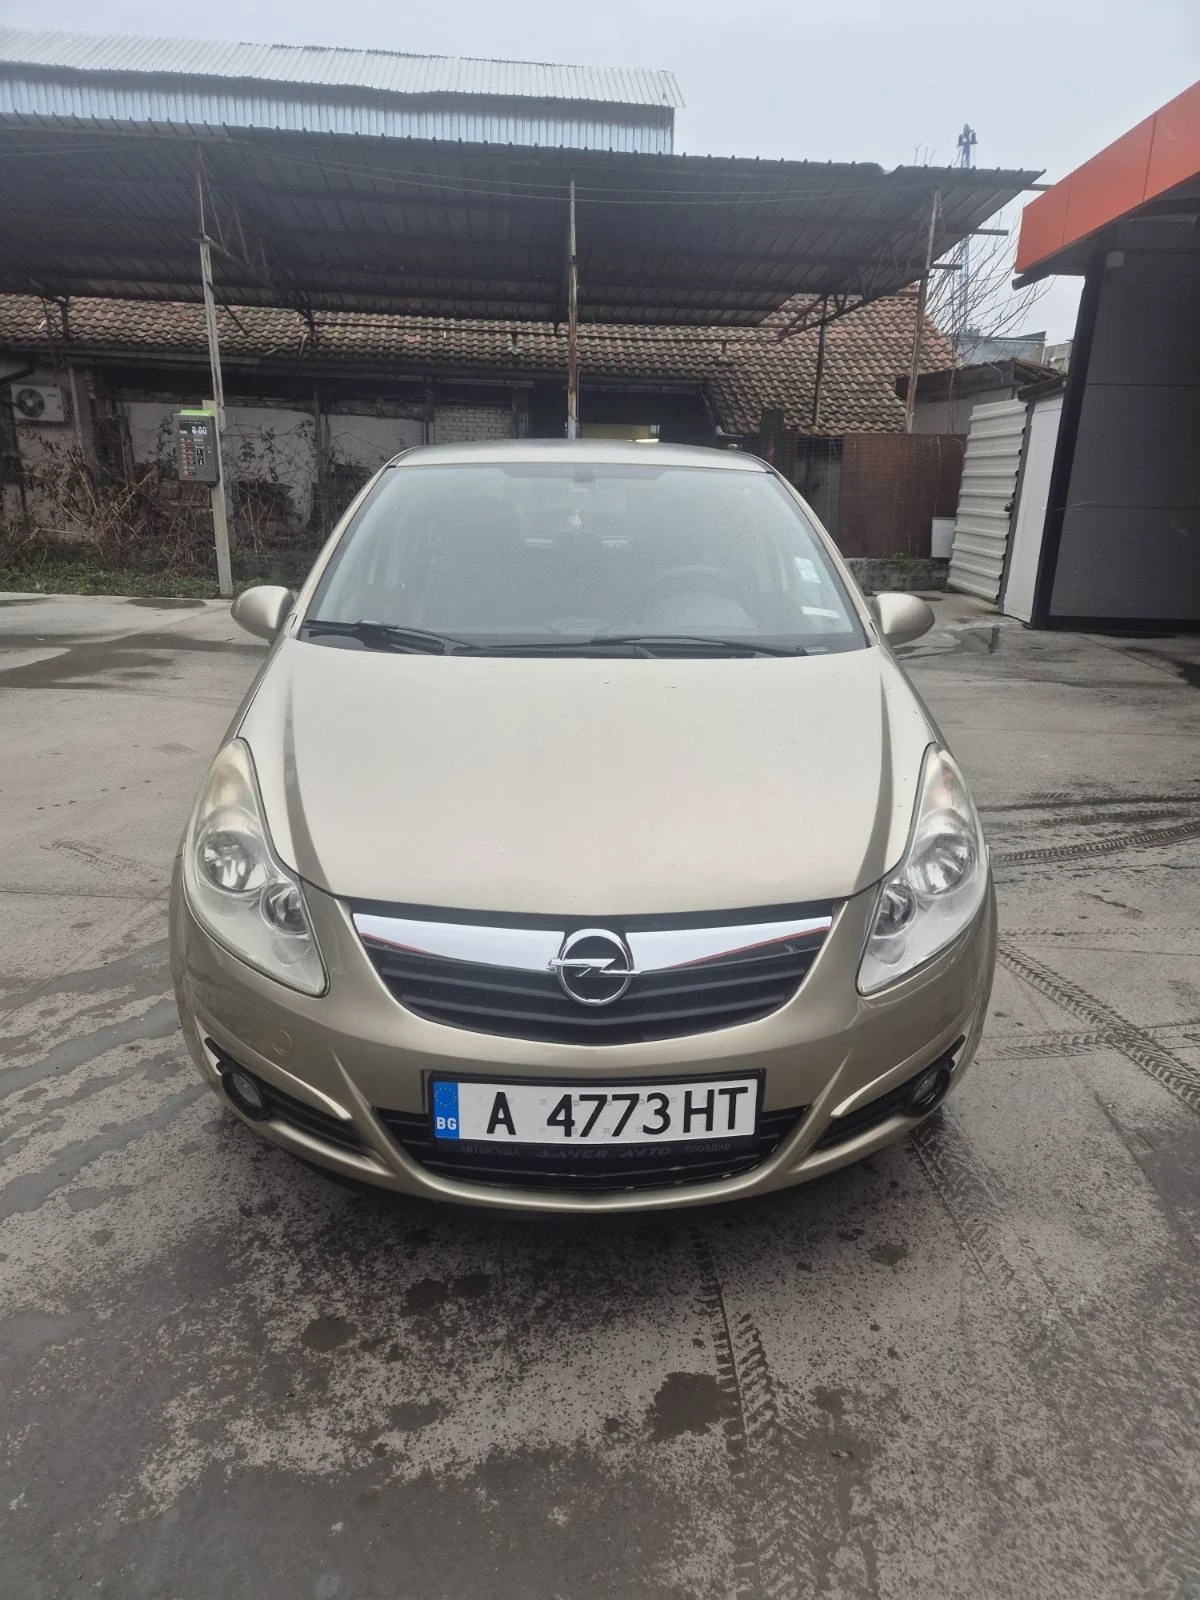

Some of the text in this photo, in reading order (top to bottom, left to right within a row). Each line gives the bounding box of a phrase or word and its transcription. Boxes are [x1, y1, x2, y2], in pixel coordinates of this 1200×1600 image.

[436, 1117, 457, 1130] BG
[487, 1087, 748, 1137] A 4773 HT
